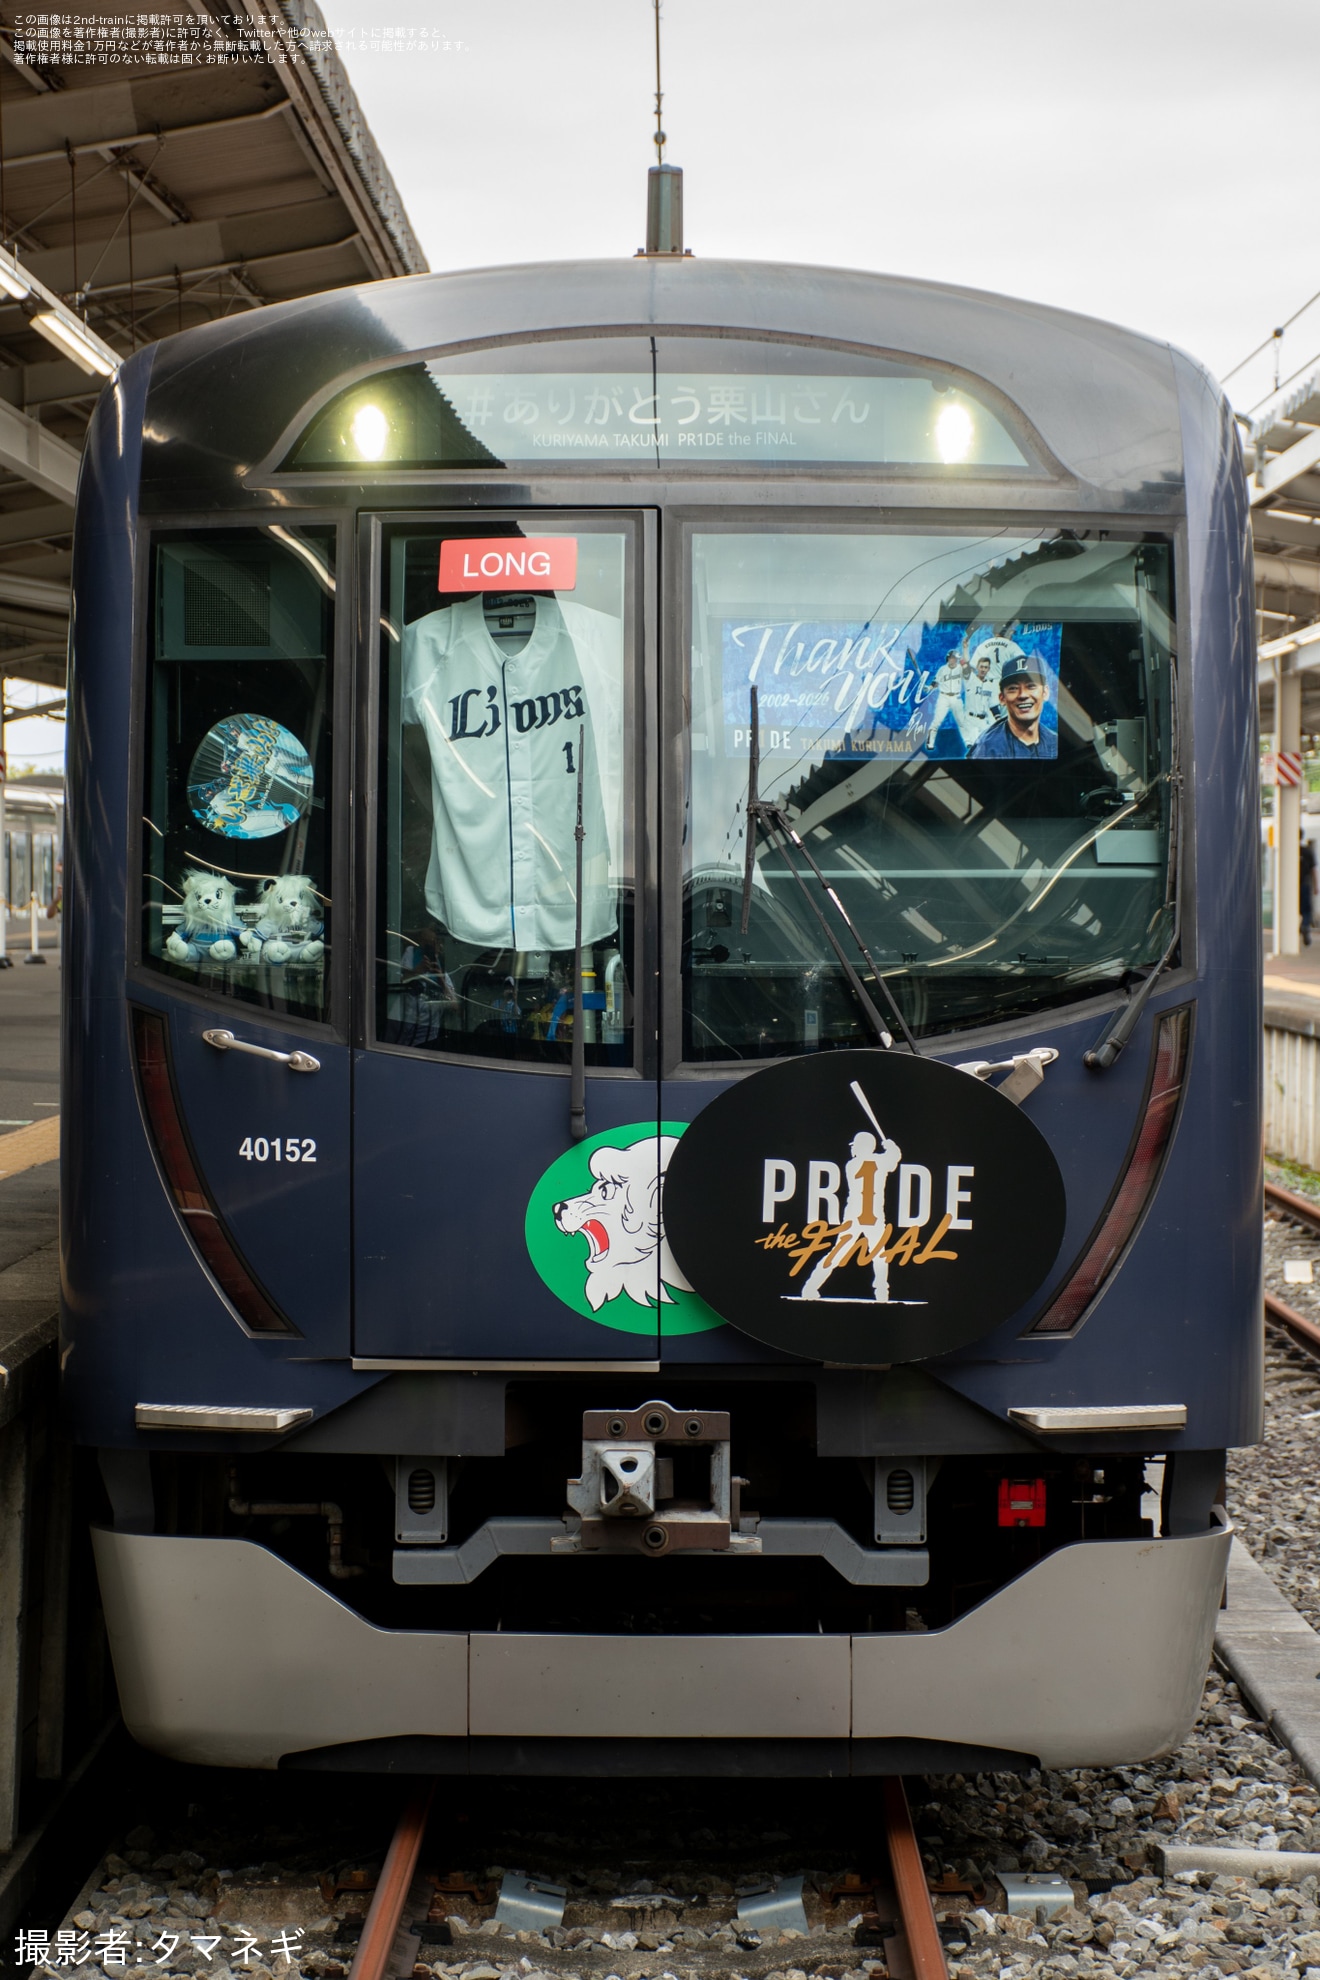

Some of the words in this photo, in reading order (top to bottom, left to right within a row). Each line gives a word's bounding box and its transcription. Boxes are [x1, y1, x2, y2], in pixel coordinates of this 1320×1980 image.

[532, 432, 609, 447] KURIYAMA
[613, 433, 669, 447] TAKUMI
[728, 432, 751, 446] the
[756, 432, 797, 446] FINAL
[463, 551, 551, 577] LONG
[731, 620, 901, 682] Thank
[448, 685, 586, 742] Lions
[562, 741, 576, 773] 1
[800, 738, 846, 751] TAKUMI
[851, 739, 913, 752] KURIYAMA
[239, 1137, 317, 1162] 40152
[754, 1222, 800, 1250] the
[788, 1213, 958, 1277] FINAL
